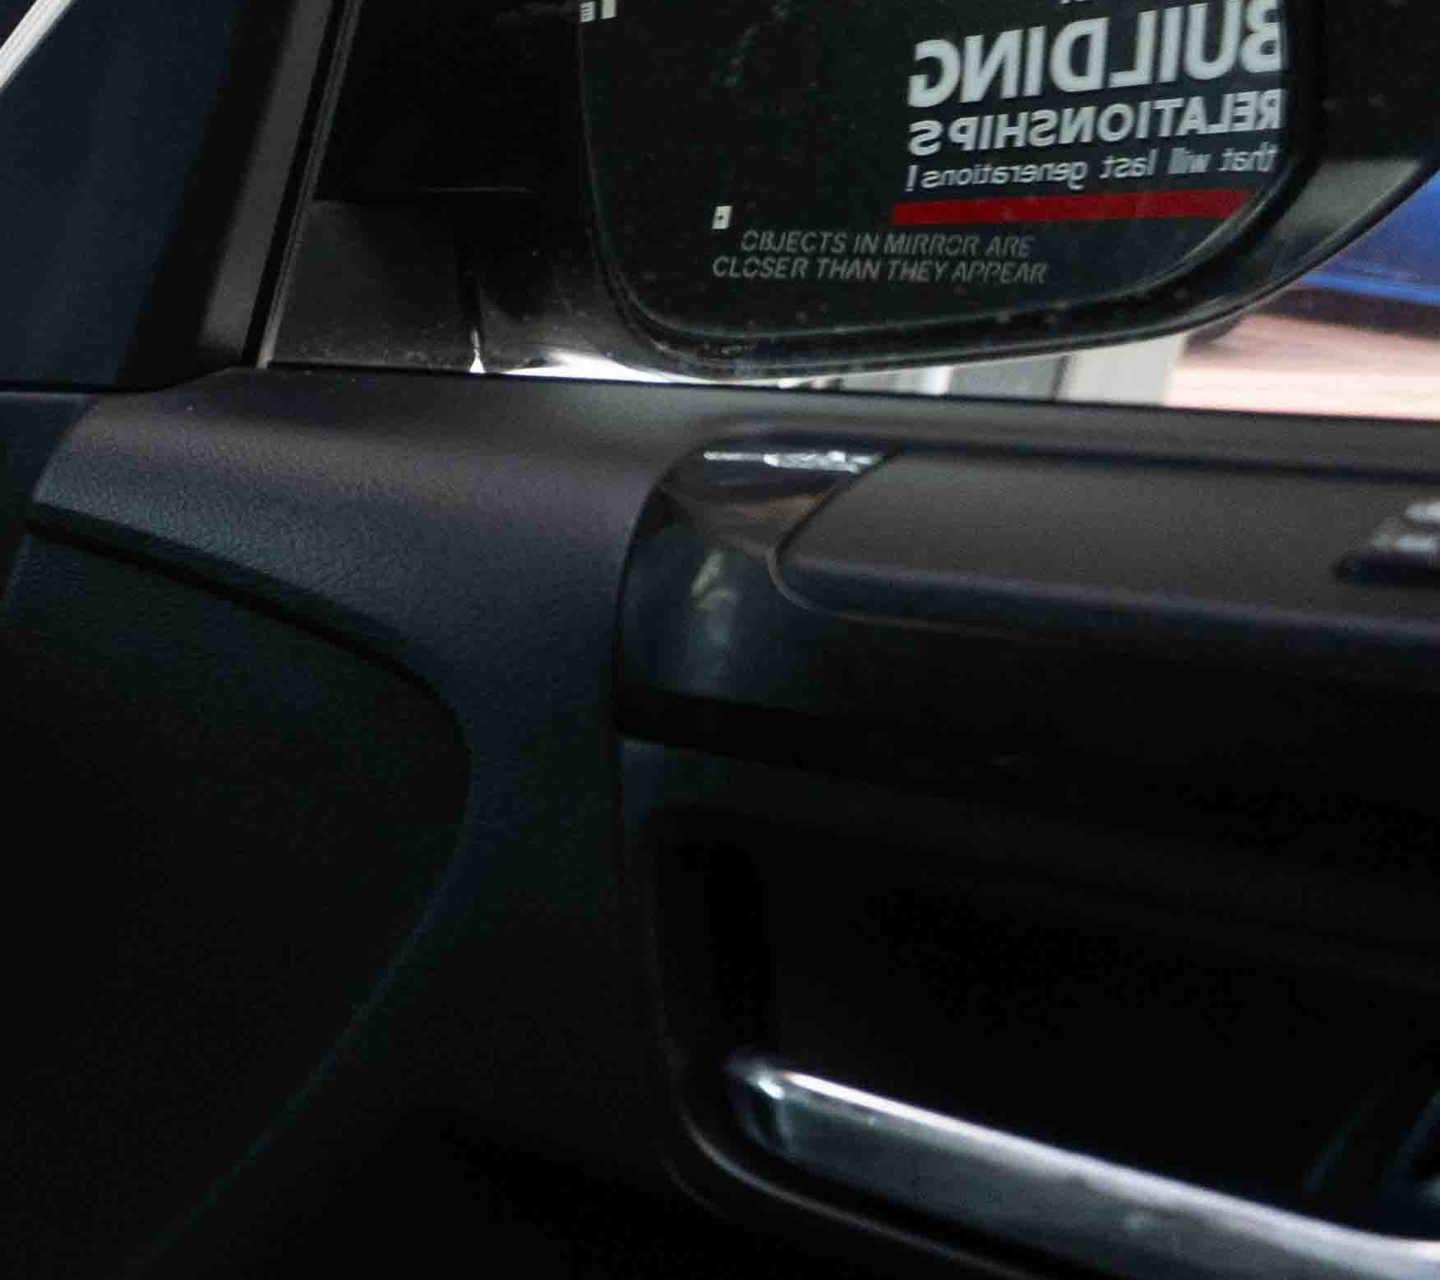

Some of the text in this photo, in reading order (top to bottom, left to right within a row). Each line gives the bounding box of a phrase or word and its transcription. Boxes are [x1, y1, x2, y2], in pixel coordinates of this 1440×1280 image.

[740, 230, 1036, 259] OBJECTS IN MIRROR ARE
[712, 256, 1048, 285] CLOSER THAN THEY APPEAR
